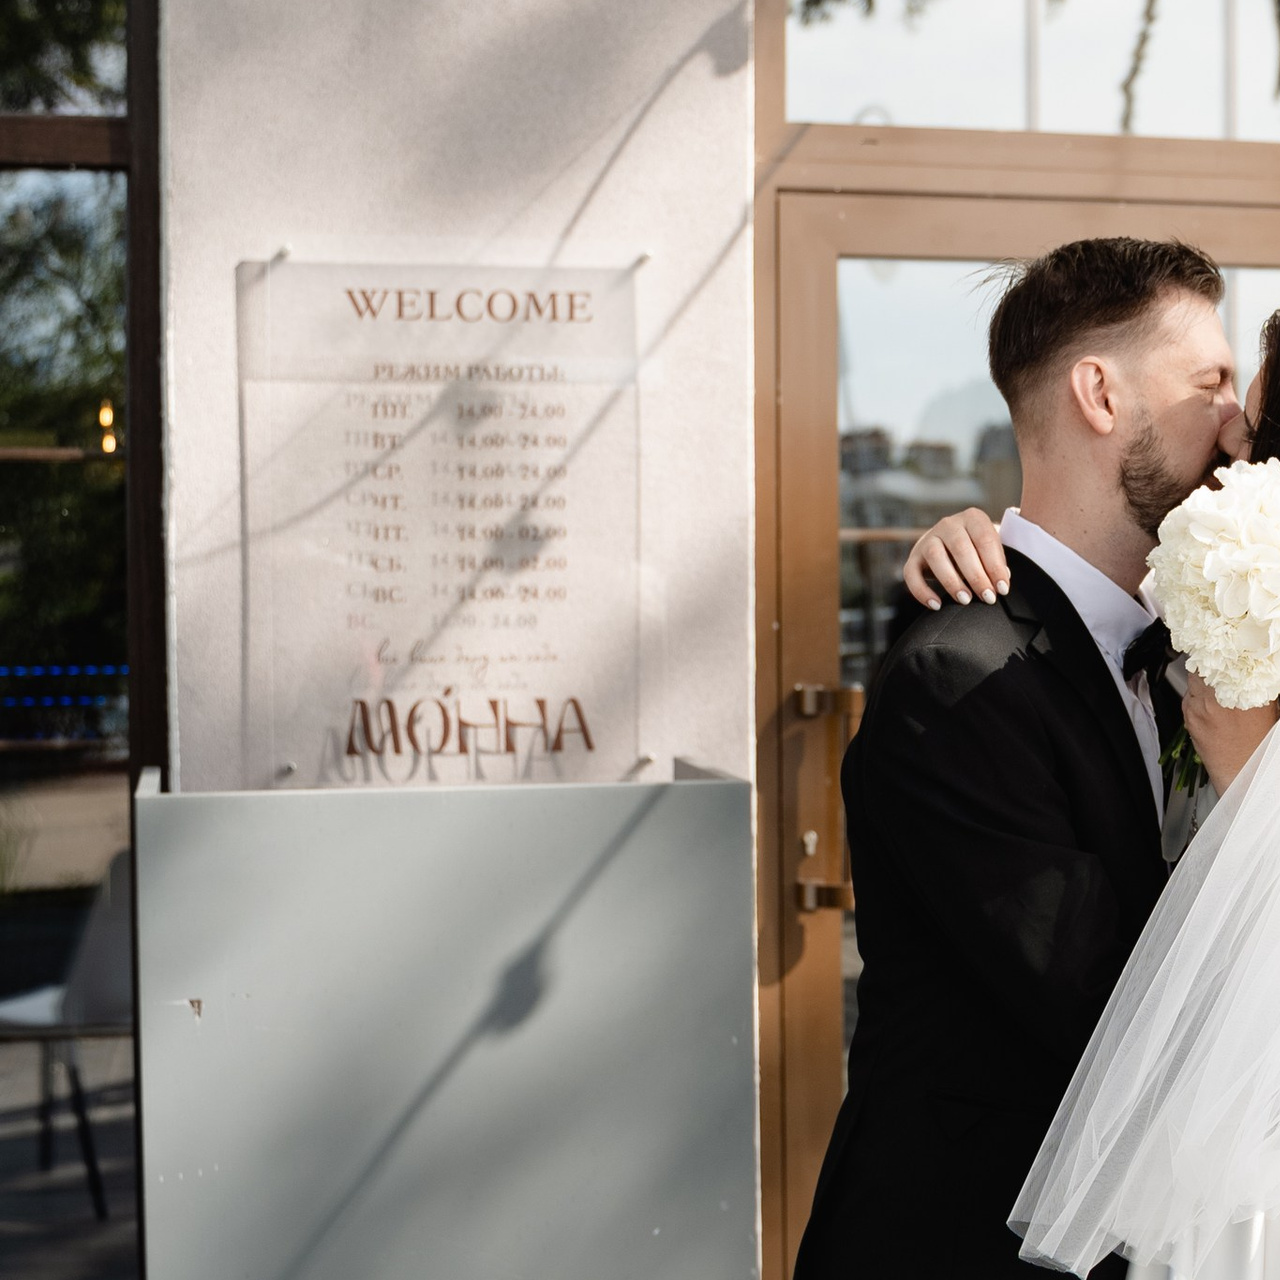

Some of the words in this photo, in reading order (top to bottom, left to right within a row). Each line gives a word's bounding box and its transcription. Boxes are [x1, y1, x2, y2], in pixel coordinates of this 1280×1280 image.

[346, 289, 593, 322] WELCOME
[372, 363, 461, 382] РЕЖИМ
[466, 363, 566, 382] РАБОТЫ:
